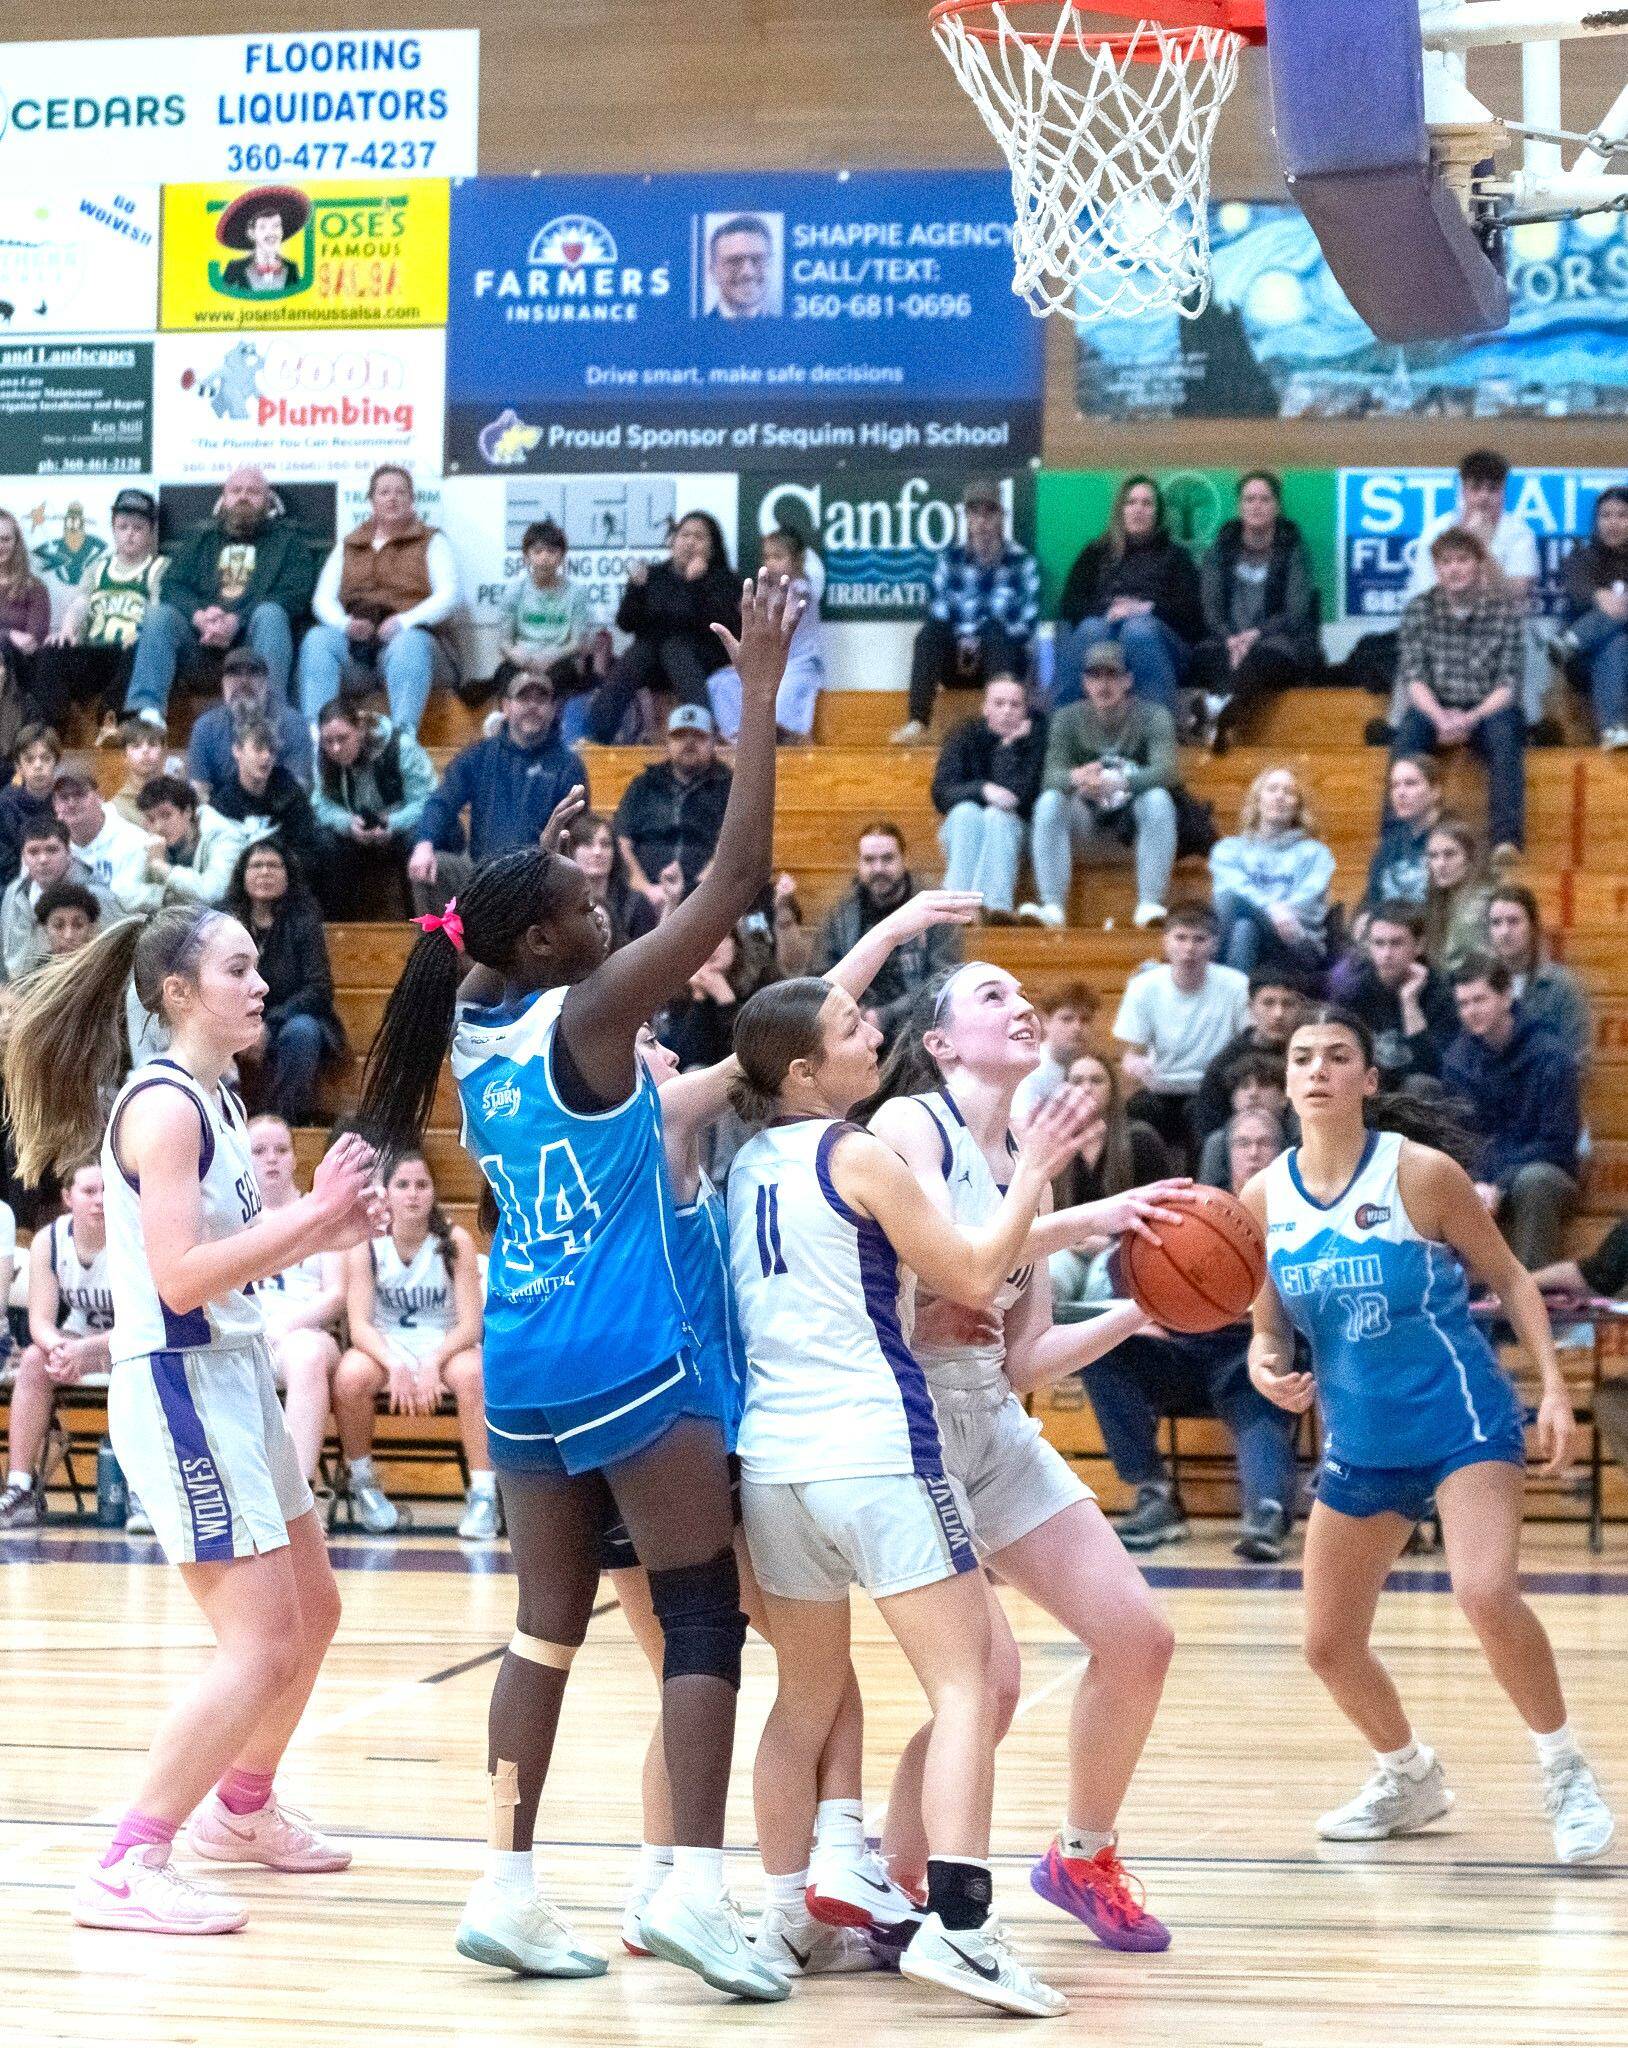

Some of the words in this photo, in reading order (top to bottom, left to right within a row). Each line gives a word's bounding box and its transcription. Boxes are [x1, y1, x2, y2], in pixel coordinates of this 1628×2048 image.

[246, 40, 422, 74] FLOORING
[12, 96, 186, 131] CEDARS
[218, 90, 448, 126] LIQUIDATORS
[227, 141, 436, 172] 360-477-4237
[79, 199, 152, 246] WOLVES!!
[794, 225, 902, 247] SHAPPIE
[321, 243, 401, 258] FAMOUS
[475, 265, 670, 299] FARMERS
[794, 260, 939, 284] CALL/TEXT:
[506, 303, 638, 322] INSURANCE
[794, 296, 971, 319] 360-681-0696
[586, 366, 641, 385] Drive
[644, 367, 703, 386] smart,
[708, 366, 758, 385] make
[762, 366, 807, 385] safe
[257, 395, 414, 432] Plumbing
[549, 425, 622, 448] Proud
[628, 425, 726, 454] Sponsor
[732, 424, 758, 447] of
[764, 425, 854, 454] Sequim
[860, 425, 920, 453] High
[926, 423, 1009, 447] School
[1360, 477, 1628, 533] STAIT
[482, 1086, 521, 1110] STORM
[480, 1138, 602, 1272] 14
[756, 1184, 788, 1278] 11
[182, 1456, 231, 1542] WOLVES
[925, 1474, 970, 1552] WOLVE
